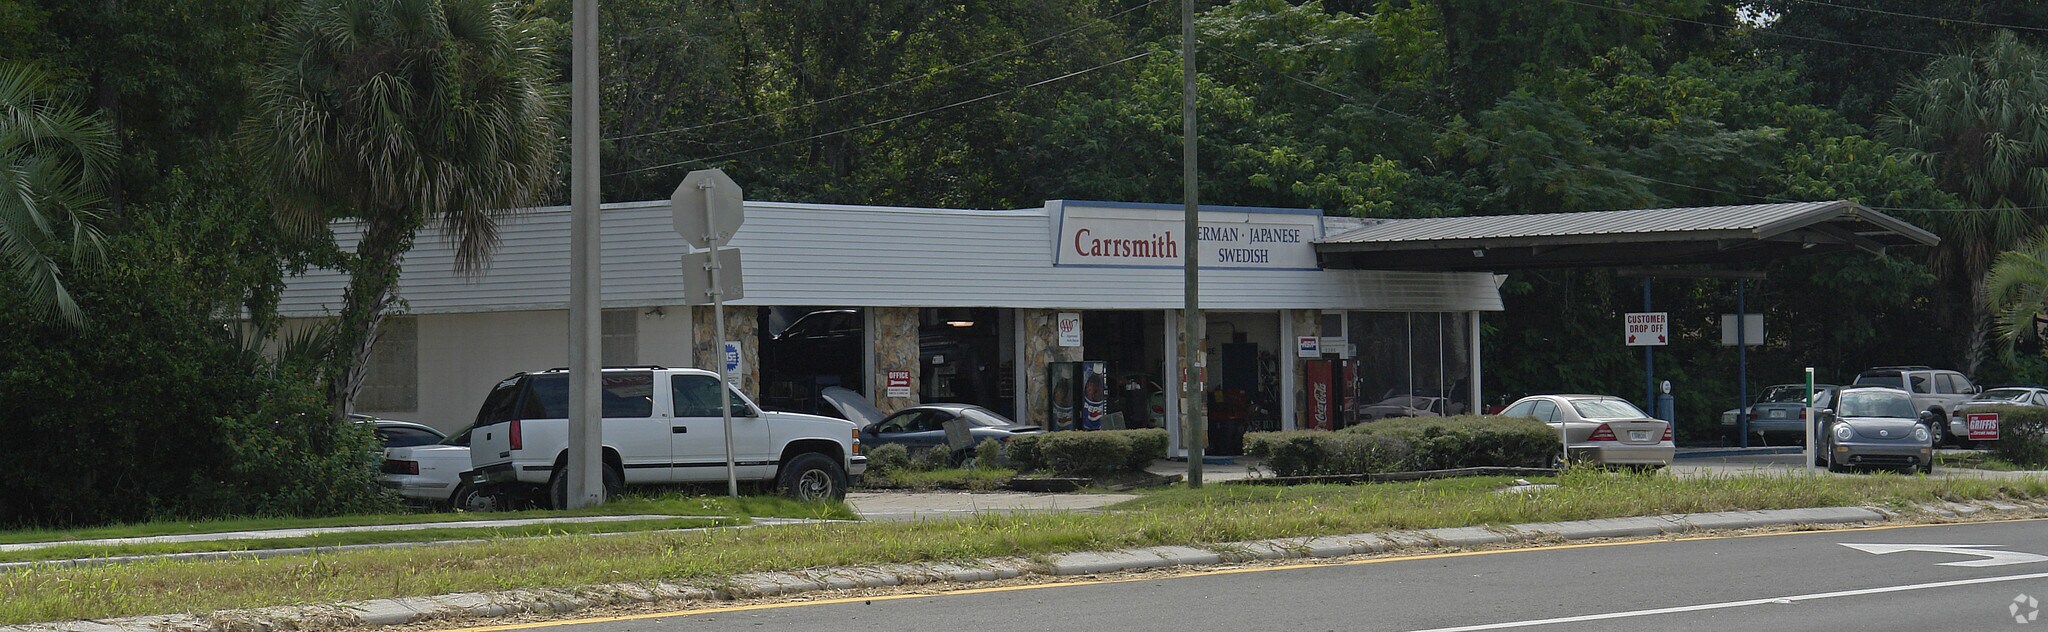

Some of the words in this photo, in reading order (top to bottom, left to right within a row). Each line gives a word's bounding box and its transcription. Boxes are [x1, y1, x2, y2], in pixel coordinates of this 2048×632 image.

[1197, 226, 1239, 242] ERMAN
[1248, 228, 1301, 245] JAPANESE
[1074, 228, 1178, 259] Carrsmith
[1218, 248, 1269, 264] SWEDISH
[1627, 314, 1666, 324] CUSTOMER
[1629, 324, 1649, 333] DROP
[1651, 324, 1664, 333] OFF
[888, 371, 909, 379] OFFICE
[1083, 402, 1104, 414] PEPS
[1970, 420, 1997, 430] GRIFFIS
